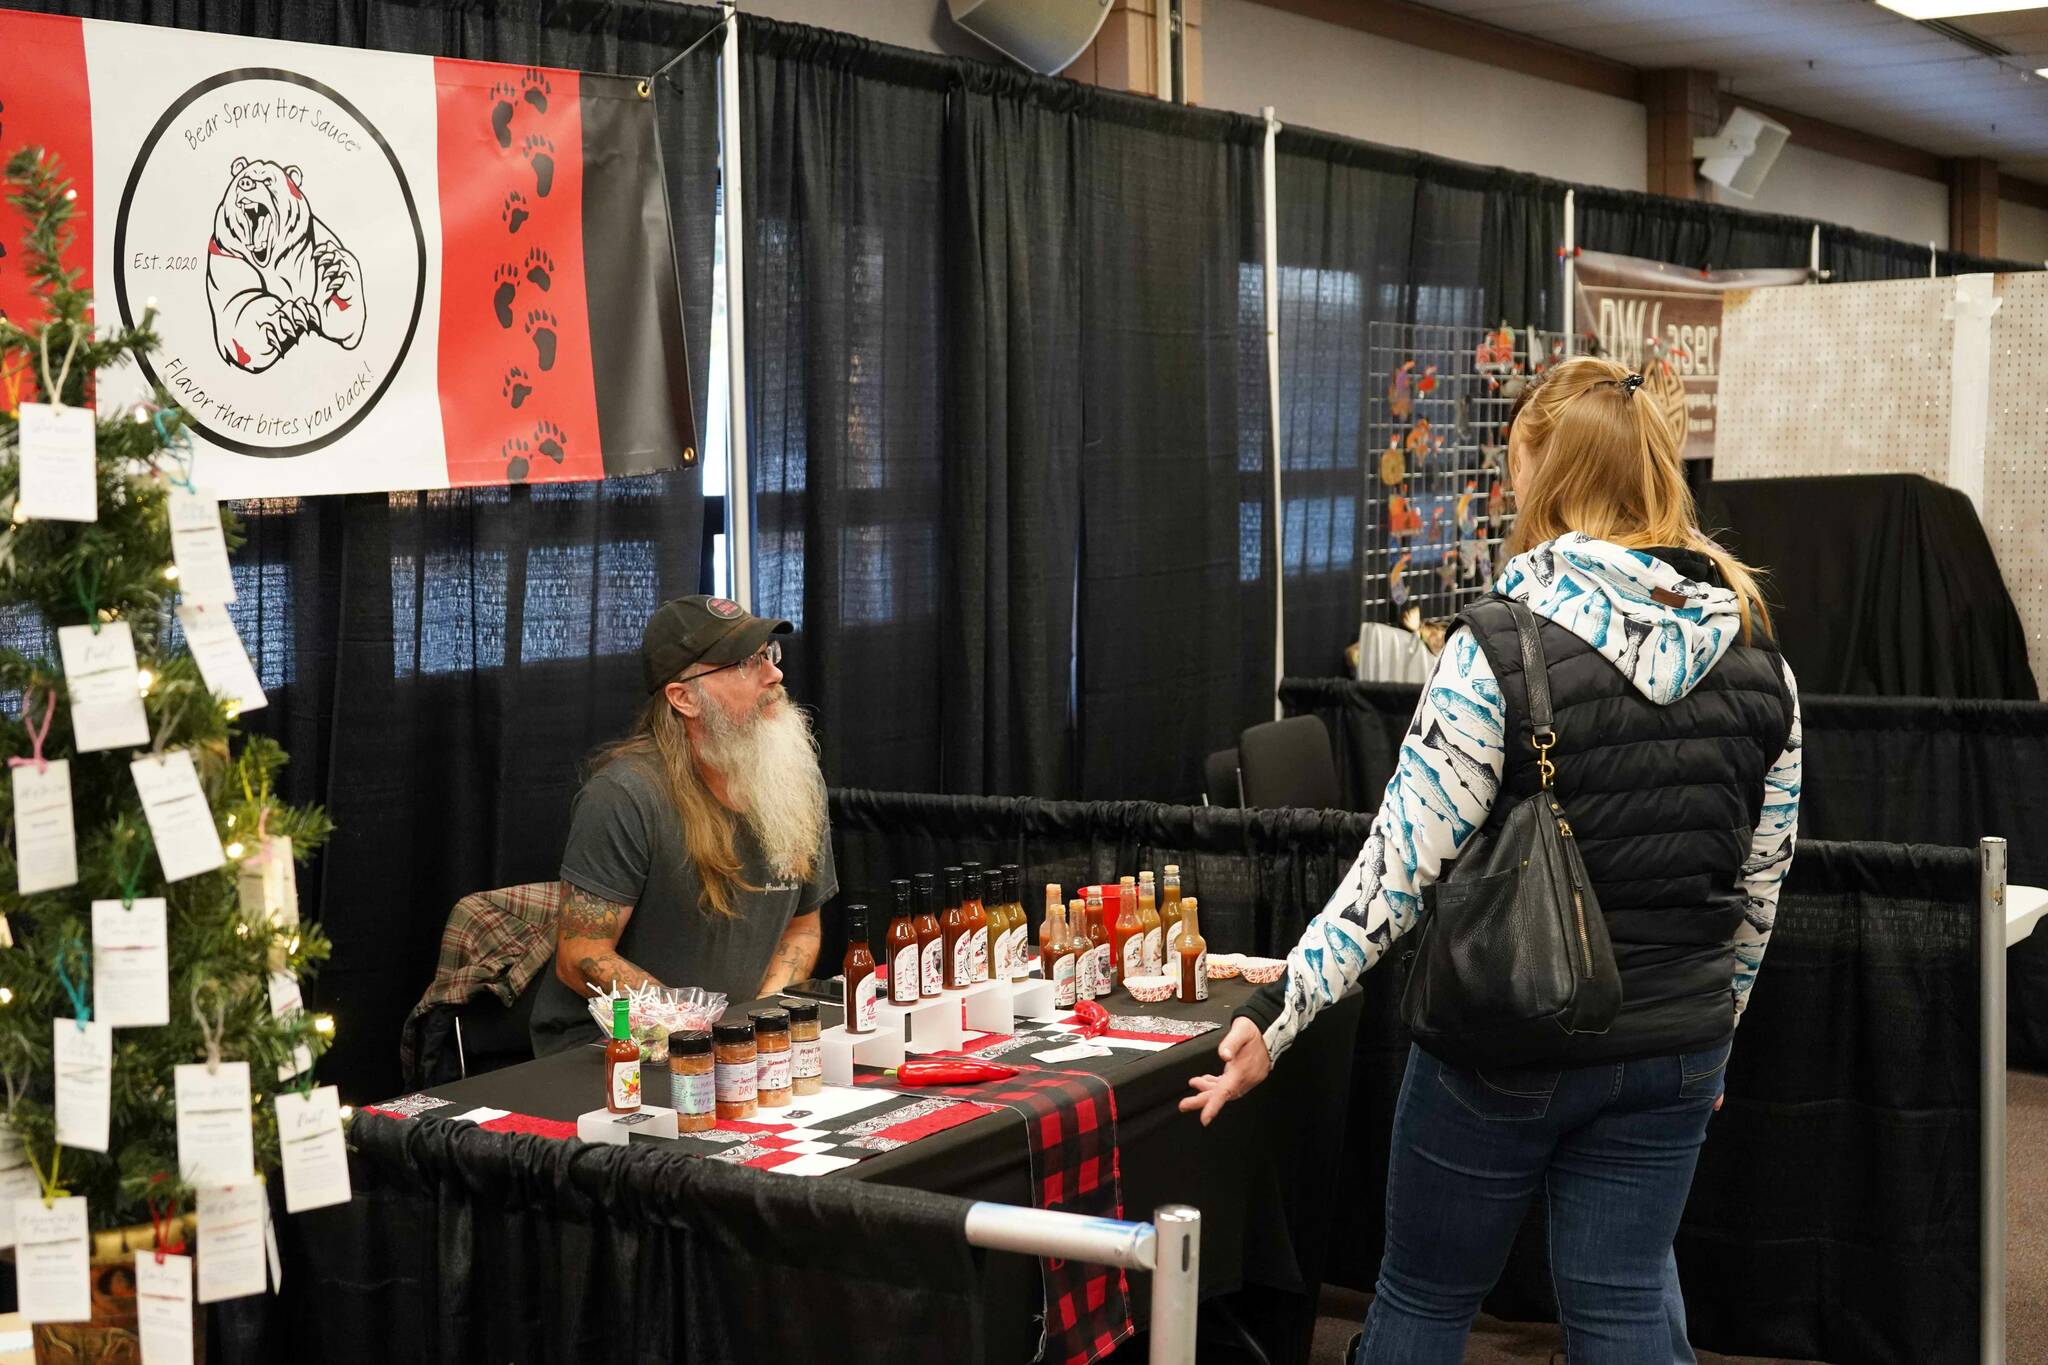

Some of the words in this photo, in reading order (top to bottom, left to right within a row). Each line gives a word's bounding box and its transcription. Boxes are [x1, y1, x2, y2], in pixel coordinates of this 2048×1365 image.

[184, 113, 218, 150] Bear
[223, 102, 270, 128] Spray
[276, 97, 309, 123] Hot
[310, 109, 356, 152] Sauce
[133, 252, 161, 270] Est.
[165, 256, 198, 271] 2020
[164, 358, 214, 409] Flavor
[214, 402, 254, 432] that
[256, 413, 300, 436] bites
[304, 406, 333, 435] you
[335, 360, 376, 412] back!
